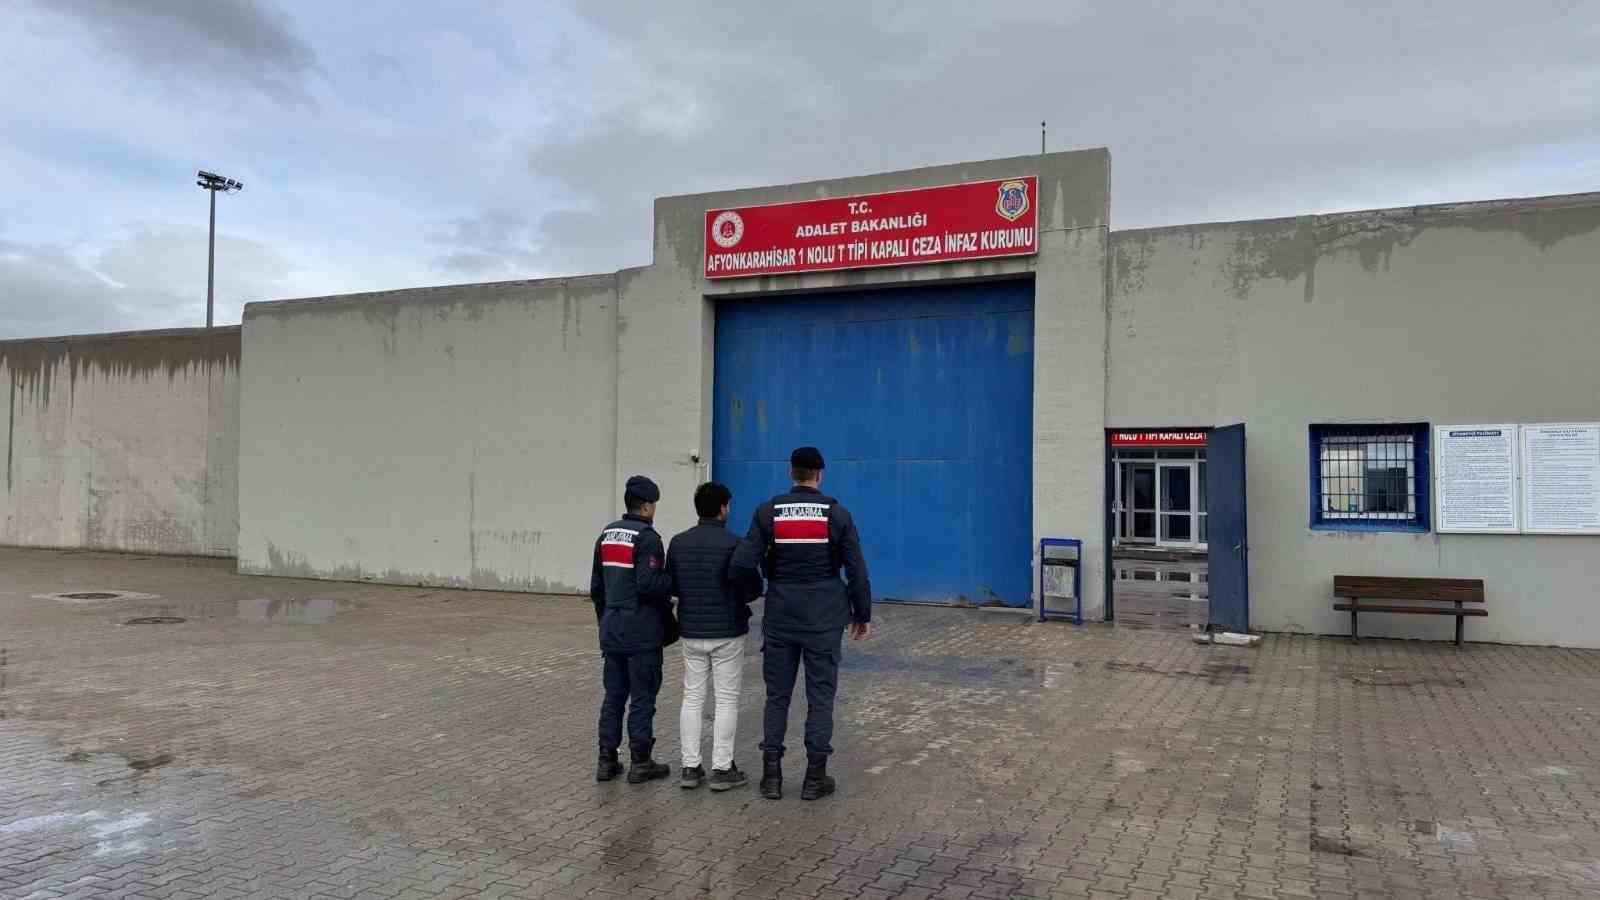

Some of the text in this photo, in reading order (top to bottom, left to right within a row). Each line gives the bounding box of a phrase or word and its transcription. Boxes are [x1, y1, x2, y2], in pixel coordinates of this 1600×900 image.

[848, 202, 872, 214] T.C.
[795, 212, 927, 238] ADALET BAKANLIĞI
[707, 227, 1033, 272] AFYONKARAHİSAR 1 NOLU T TİPİ KAPALI CEZA İNFAZ KURUMU
[779, 507, 823, 518] JANDARMA
